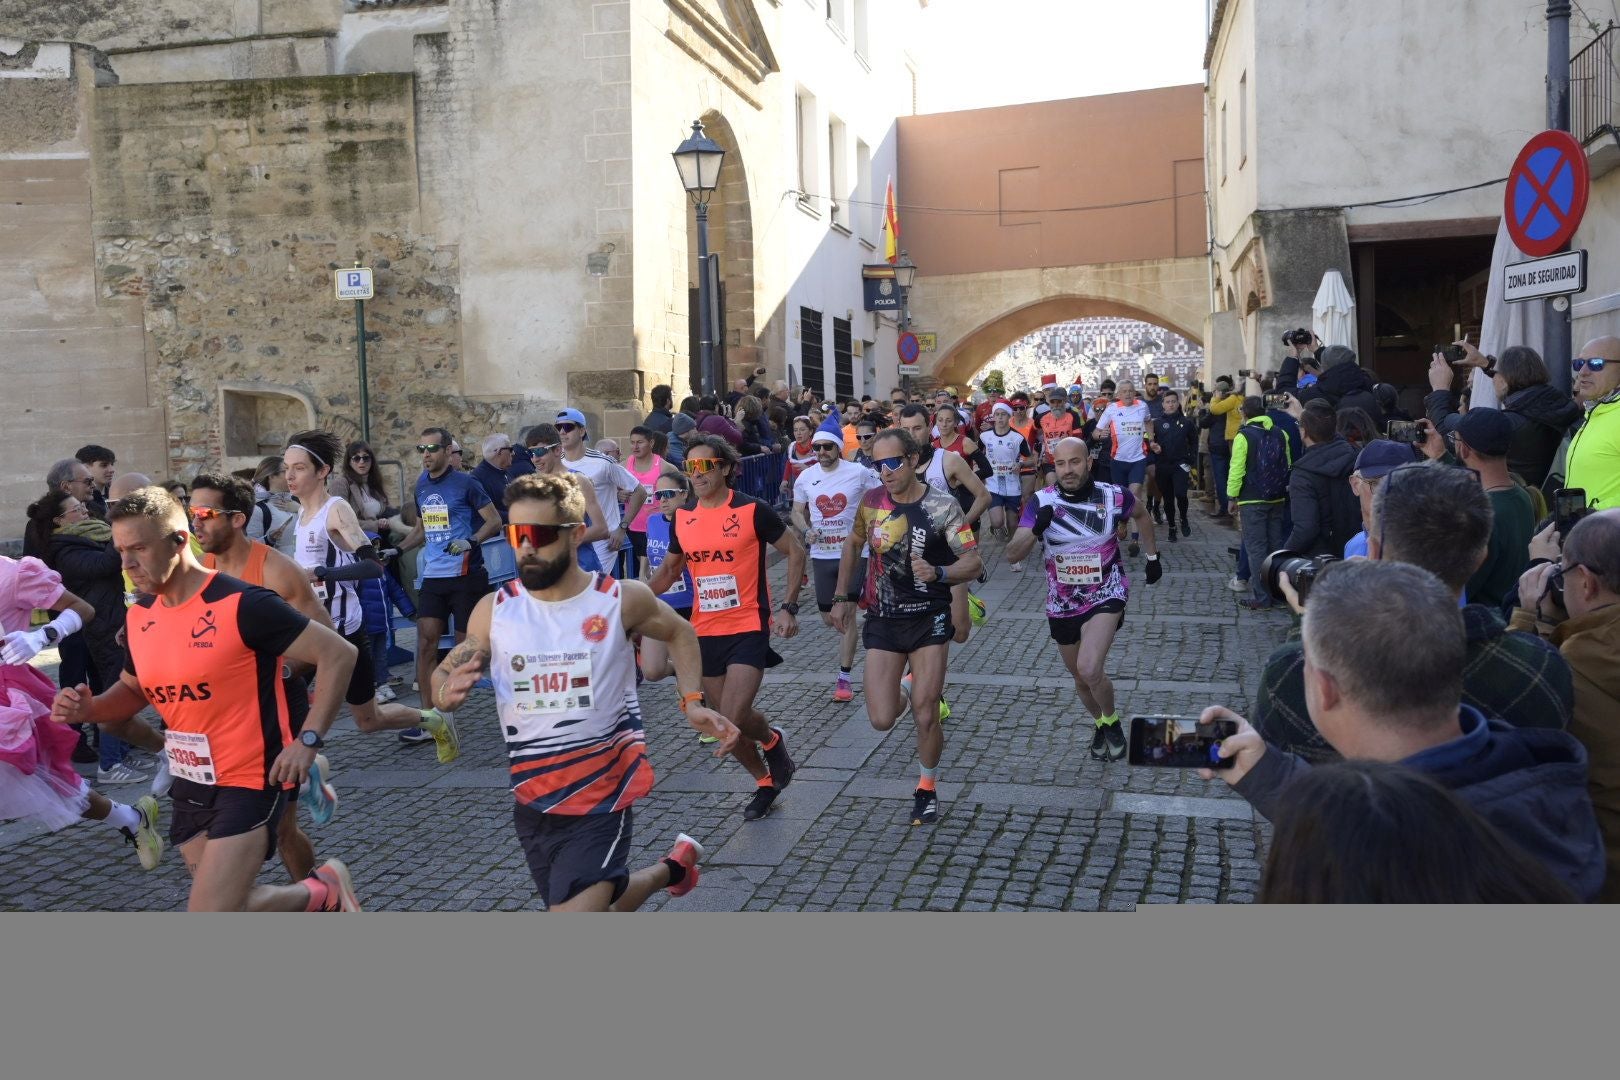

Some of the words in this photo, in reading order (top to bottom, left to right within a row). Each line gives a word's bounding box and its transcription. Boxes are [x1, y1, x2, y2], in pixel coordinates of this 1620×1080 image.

[350, 274, 359, 286] P
[1508, 273, 1526, 289] ZONA
[1527, 271, 1536, 285] DE
[1537, 264, 1576, 284] SEGURIDAD
[685, 549, 734, 563] ASFAS
[1065, 565, 1090, 575] 2330
[703, 588, 726, 600] 2460
[531, 671, 569, 694] 1147
[145, 682, 212, 704] ASFAS
[171, 747, 200, 768] 1339
